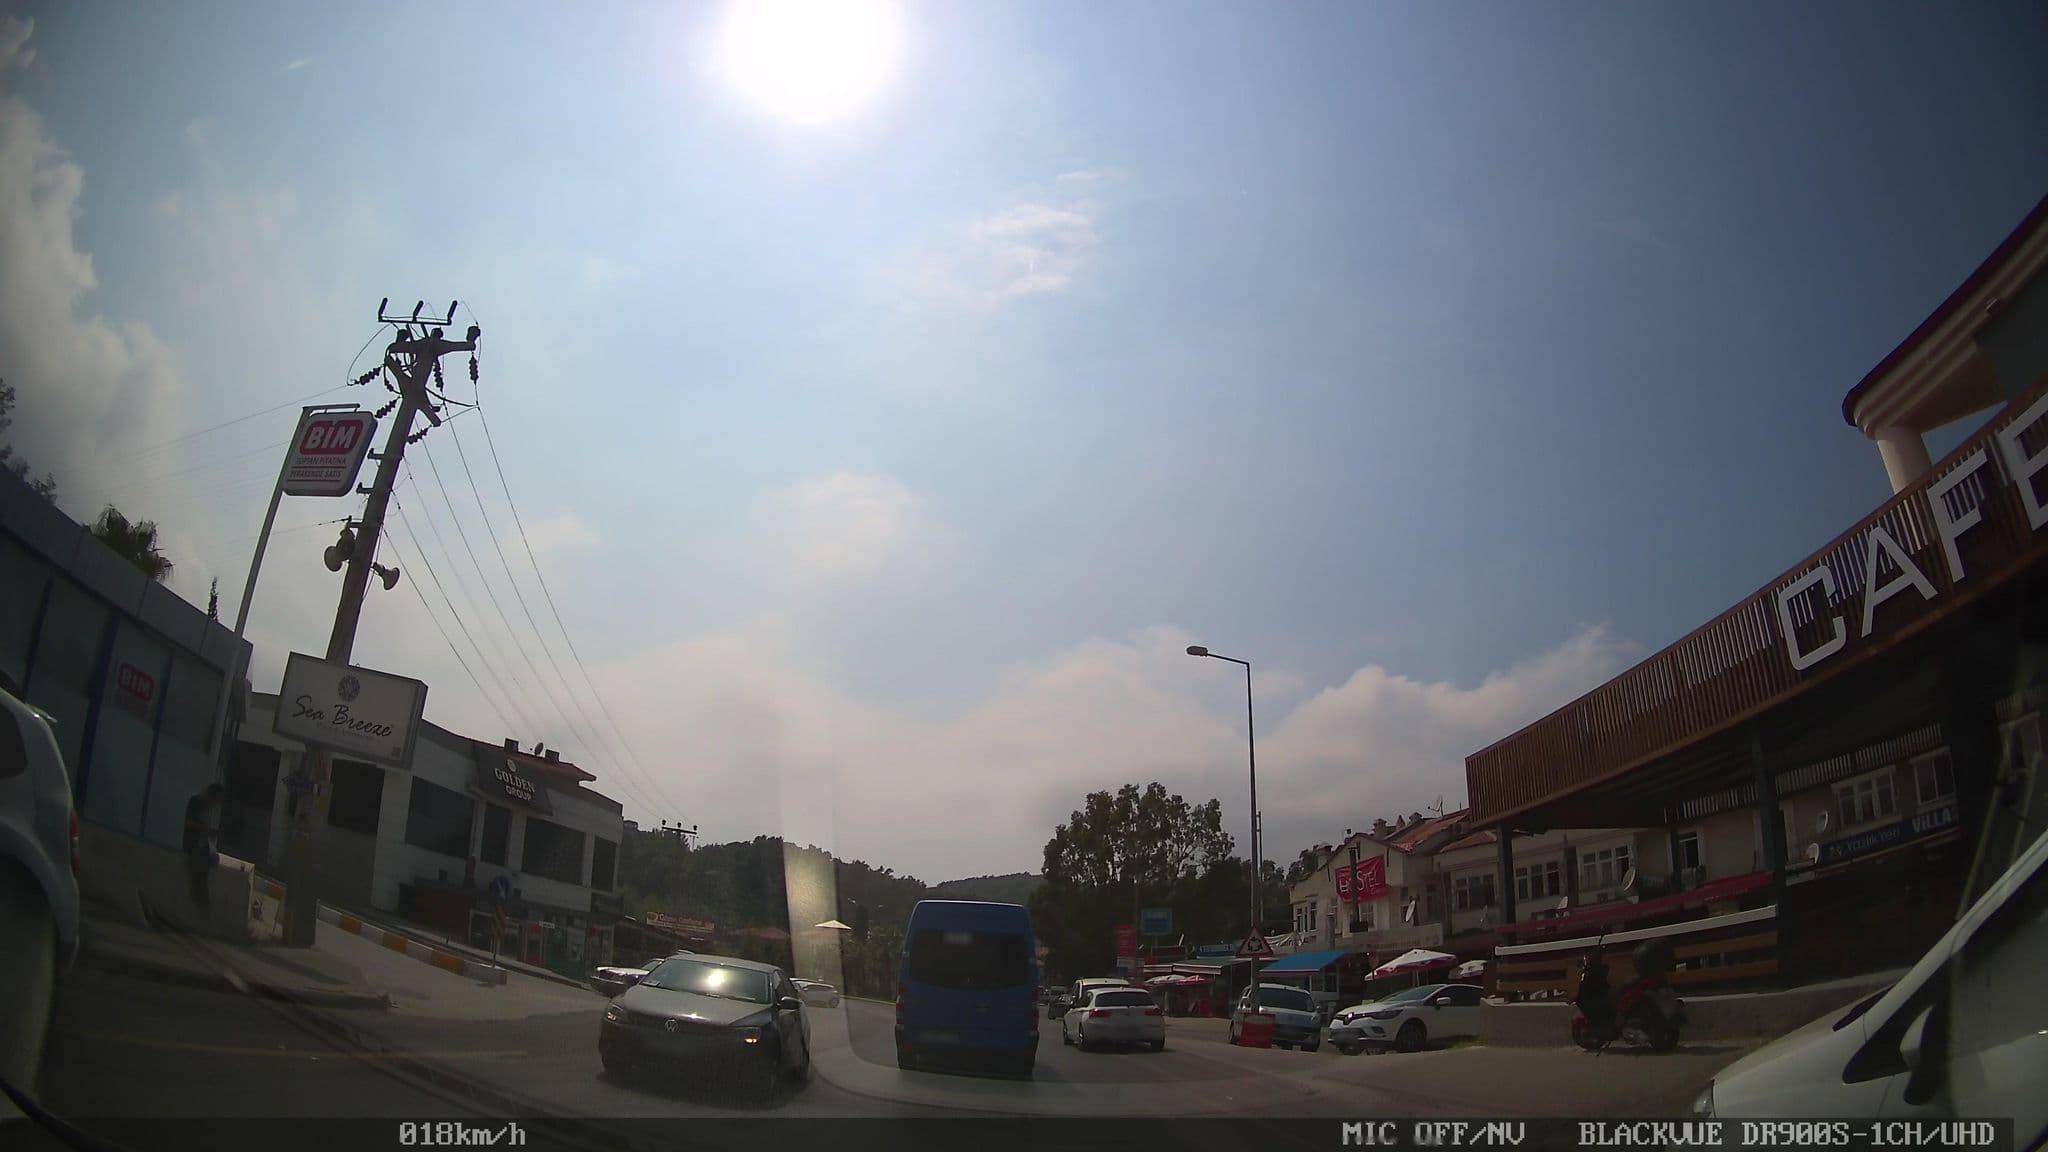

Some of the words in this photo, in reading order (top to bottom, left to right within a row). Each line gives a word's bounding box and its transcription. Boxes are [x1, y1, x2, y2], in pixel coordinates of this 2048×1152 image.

[1779, 392, 2048, 671] CAFE
[291, 695, 326, 721] Sea
[332, 704, 392, 737] Breeze
[494, 767, 535, 794] GOLDEN
[505, 785, 532, 801] GROUP
[1339, 863, 1380, 892] HSTEL
